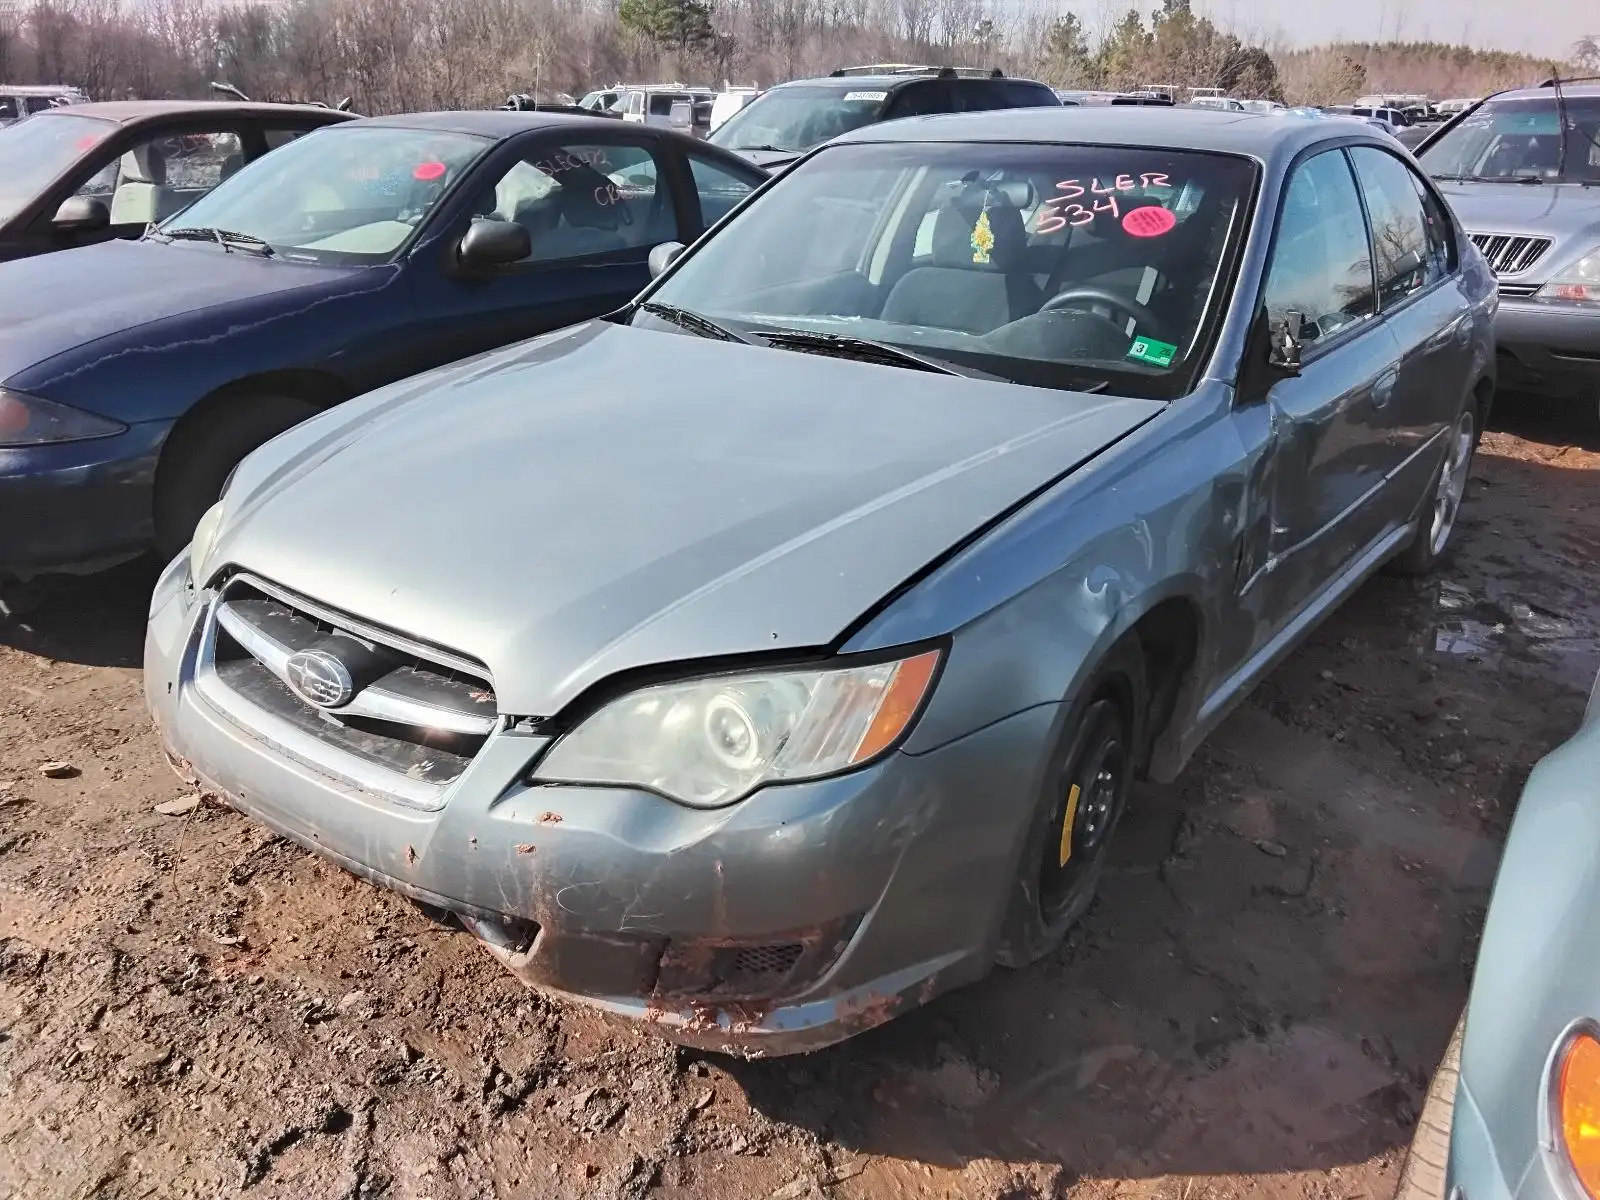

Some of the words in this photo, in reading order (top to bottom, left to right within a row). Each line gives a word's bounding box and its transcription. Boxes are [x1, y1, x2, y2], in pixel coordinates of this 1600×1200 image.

[1045, 172, 1172, 203] SLER
[1036, 195, 1120, 234] 534
[1136, 343, 1145, 353] 3
